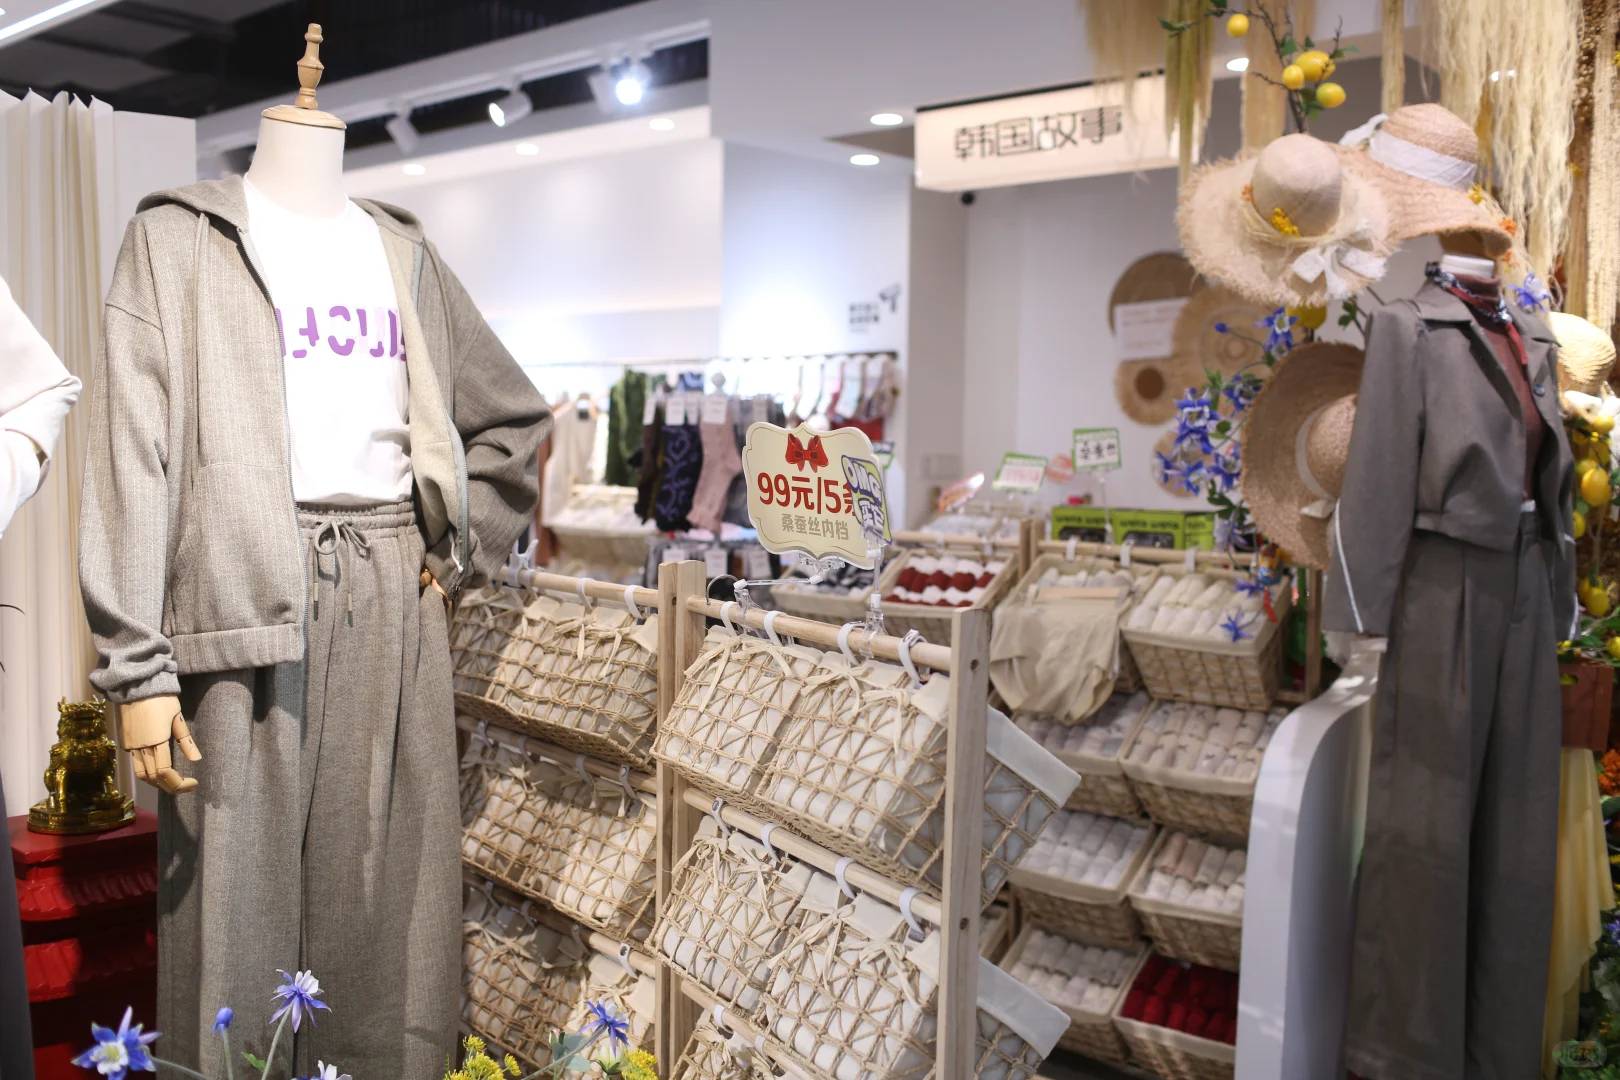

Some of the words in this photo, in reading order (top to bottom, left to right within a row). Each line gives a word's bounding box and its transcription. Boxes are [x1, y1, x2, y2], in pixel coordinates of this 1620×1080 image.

[955, 106, 1122, 161] 韩国故事
[842, 456, 882, 504] OMG
[781, 513, 849, 540] 桑蚕丝内档
